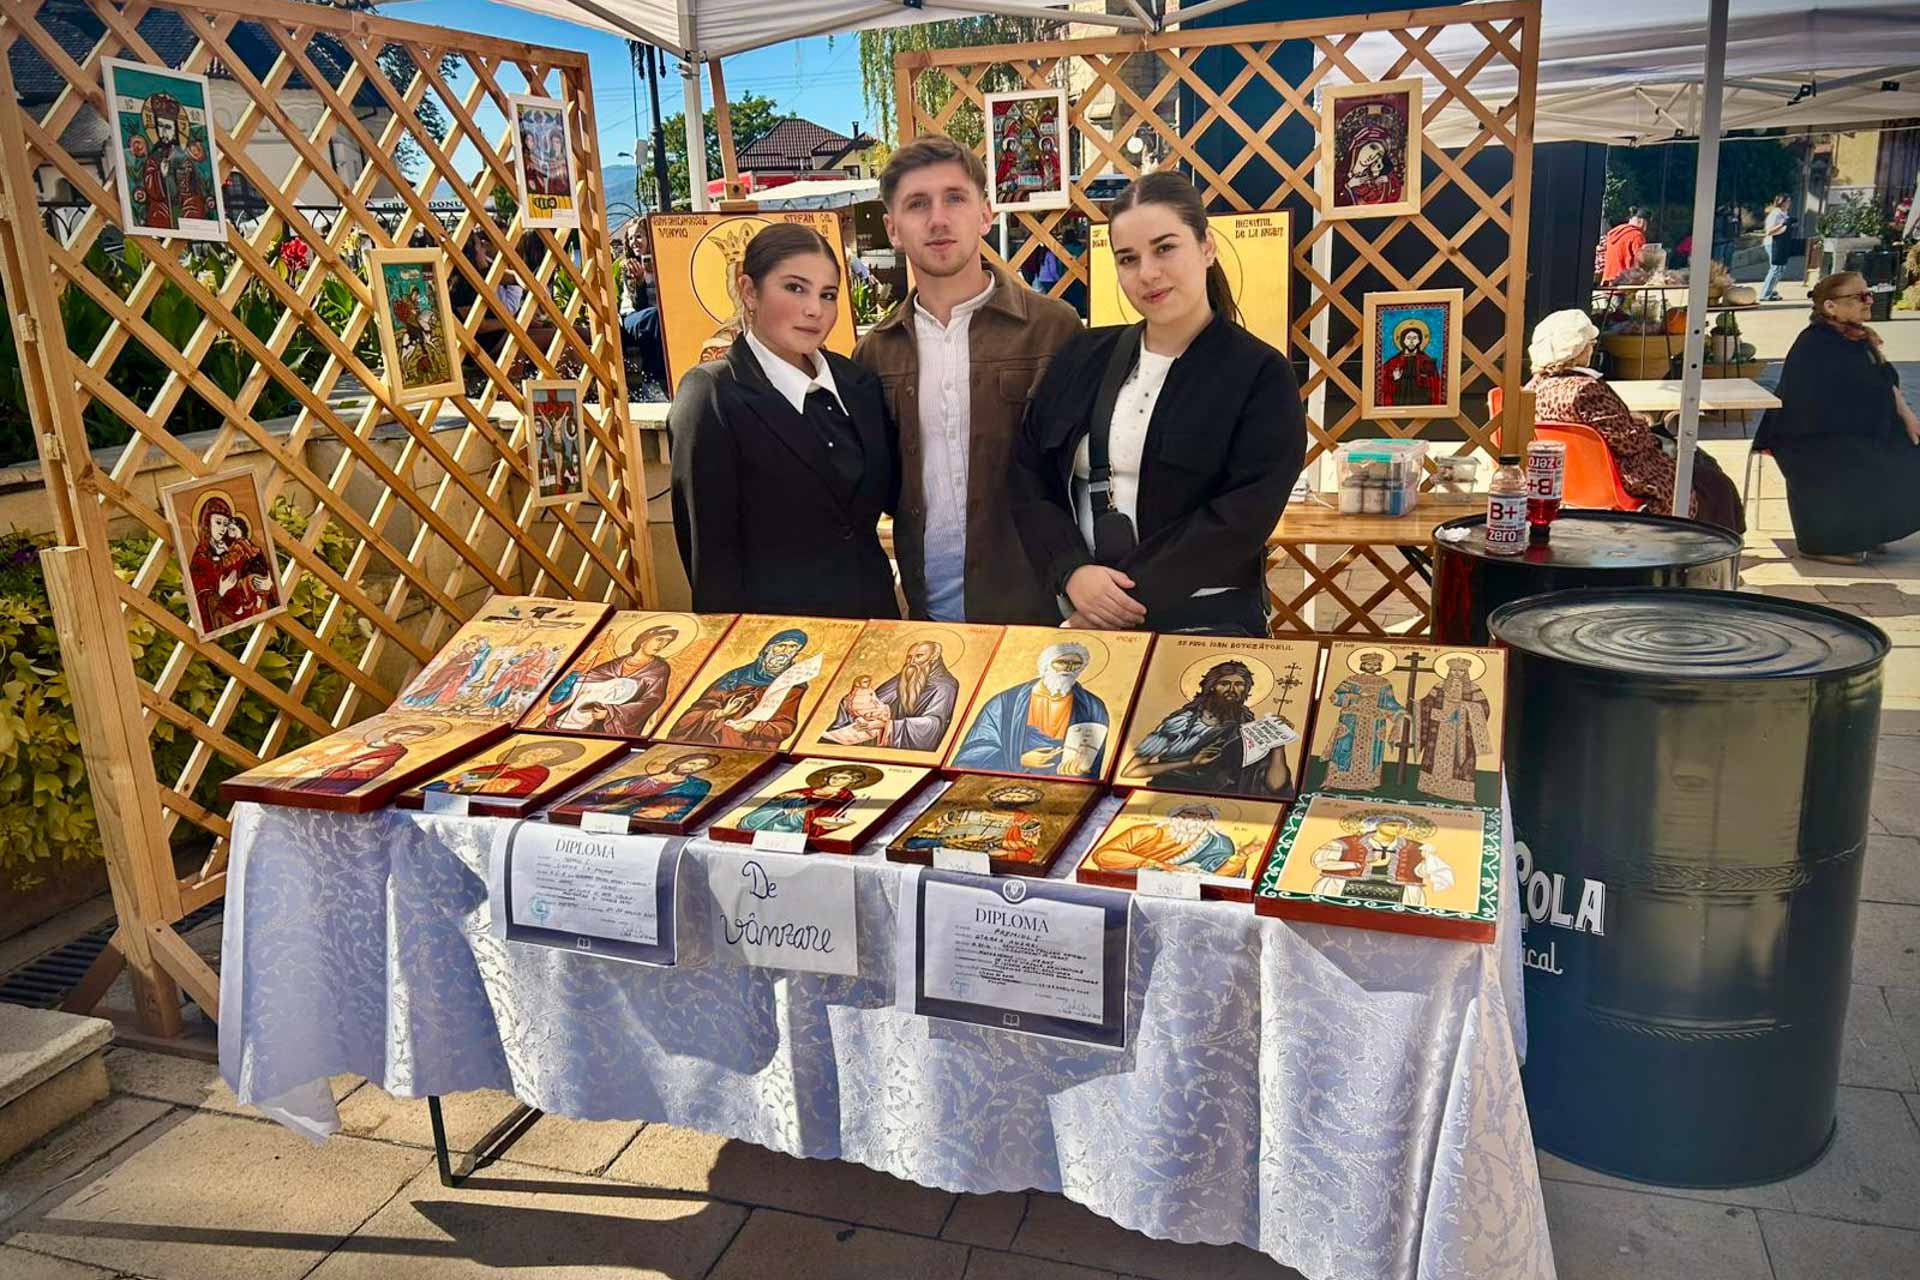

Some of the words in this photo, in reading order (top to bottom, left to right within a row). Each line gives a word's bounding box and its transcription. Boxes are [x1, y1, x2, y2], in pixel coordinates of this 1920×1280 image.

[1528, 456, 1555, 469] zero
[1490, 502, 1518, 521] B+
[1488, 529, 1517, 542] zero
[555, 838, 616, 860] DIPLOMA
[741, 860, 778, 899] De
[975, 907, 1050, 934] DIPLOMA
